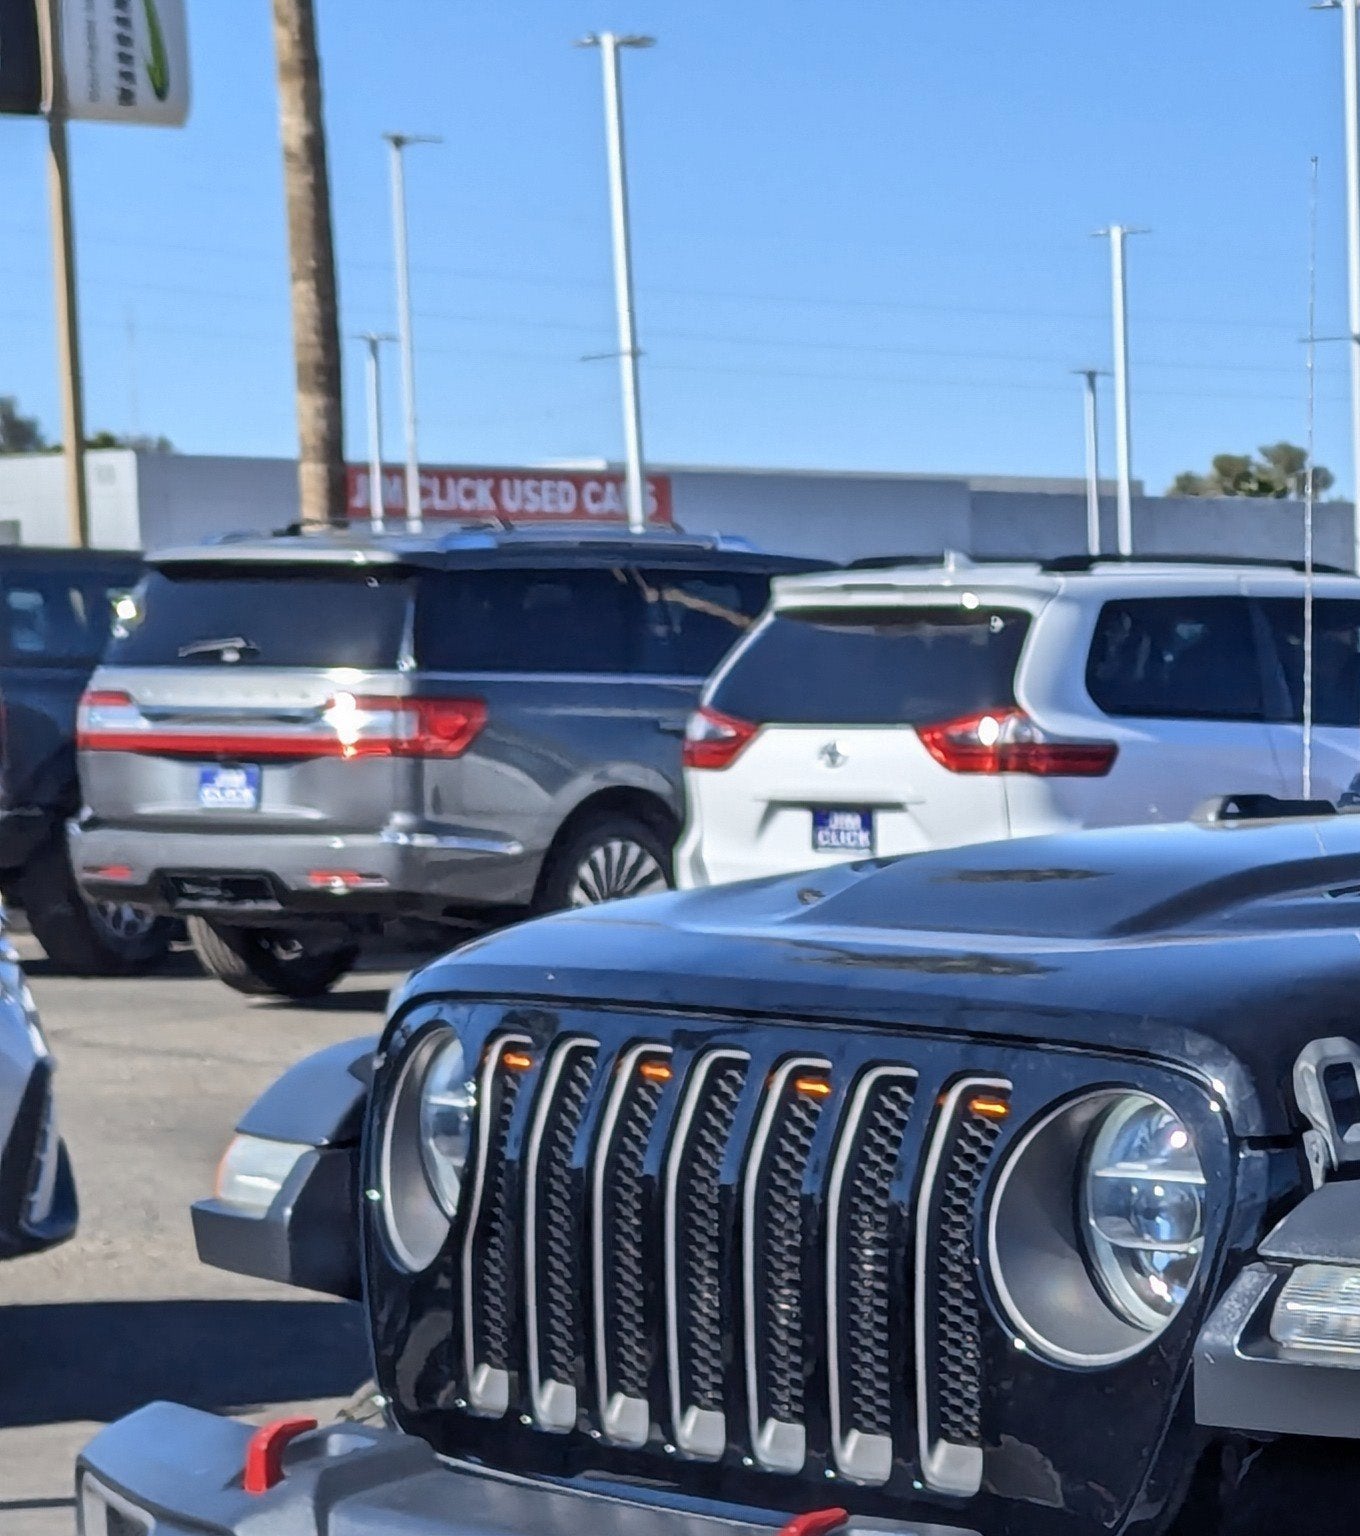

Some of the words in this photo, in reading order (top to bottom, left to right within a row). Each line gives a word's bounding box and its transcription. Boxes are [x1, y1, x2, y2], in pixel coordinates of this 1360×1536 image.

[353, 474, 408, 510] JM
[418, 475, 495, 512] CLICK
[502, 478, 576, 514] USED
[581, 480, 657, 516] CAS
